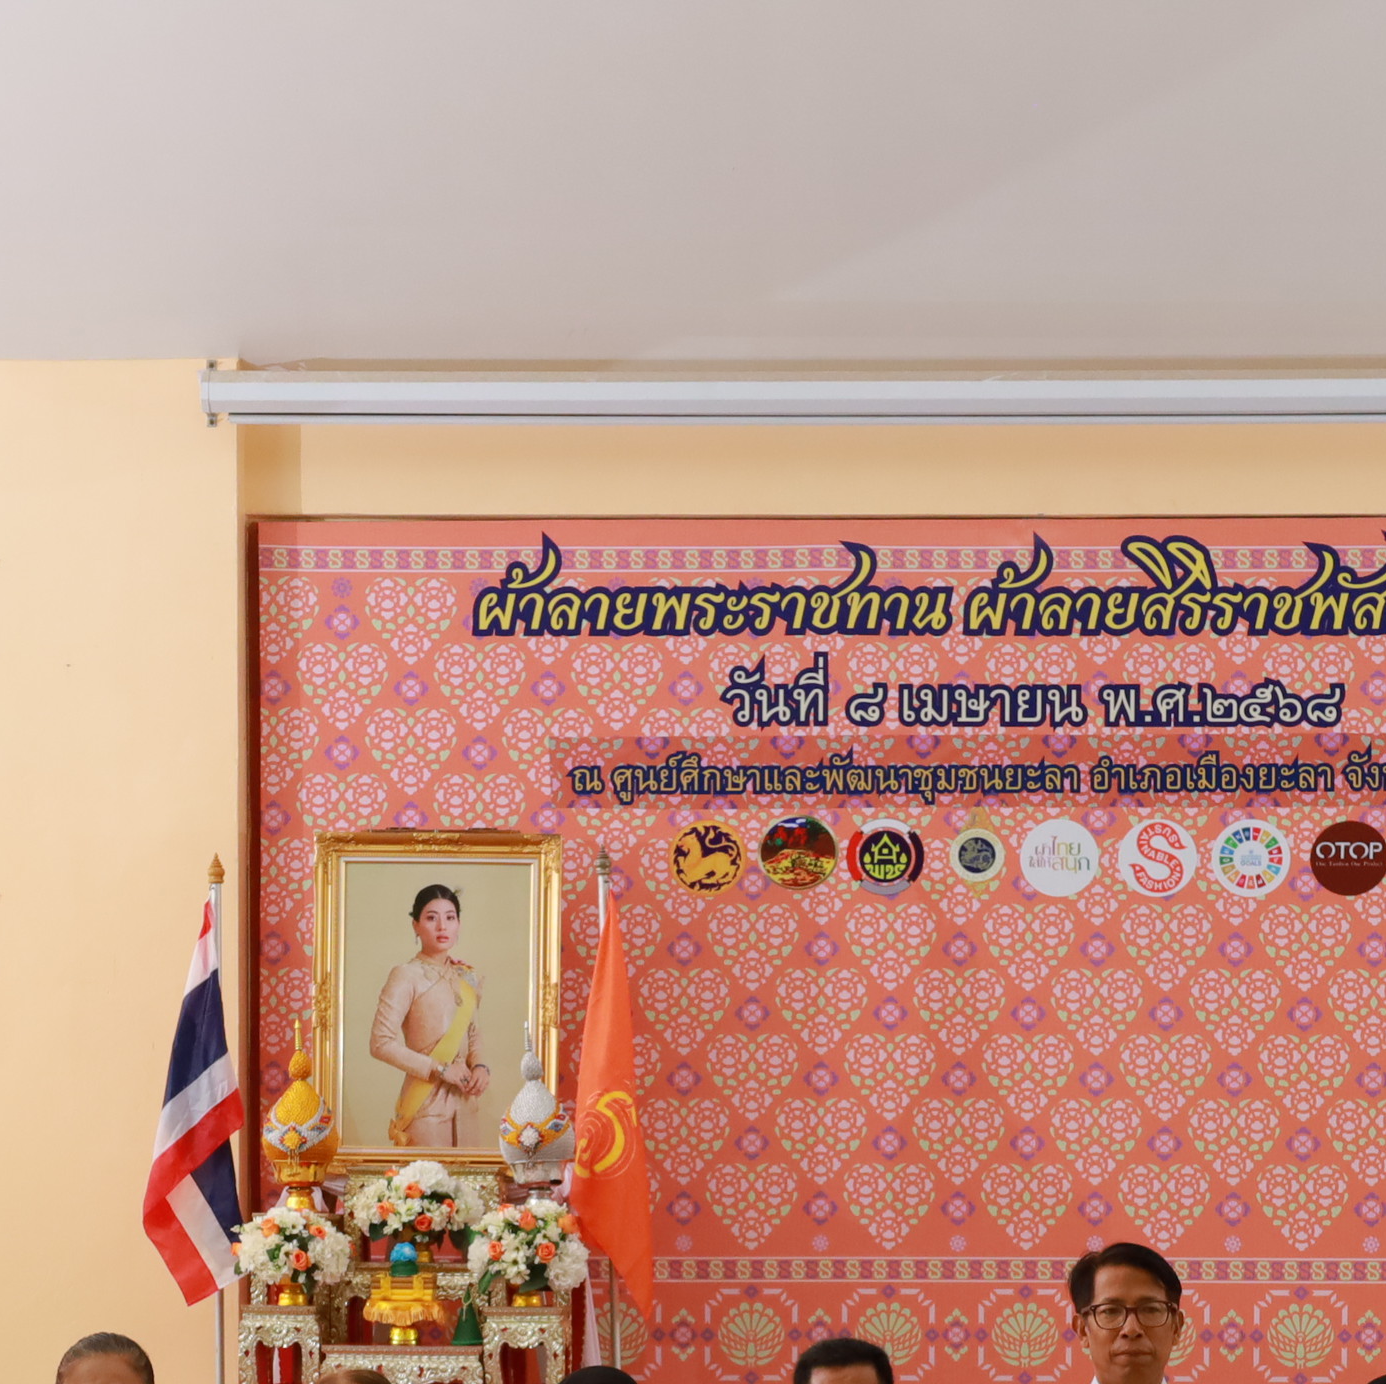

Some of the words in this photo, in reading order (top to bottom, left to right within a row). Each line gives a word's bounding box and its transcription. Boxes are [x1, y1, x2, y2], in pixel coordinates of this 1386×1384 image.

[476, 538, 950, 634] ผ้าลายพระราชทาน
[725, 655, 829, 724] วันที่
[848, 685, 885, 725] ๘
[901, 685, 1083, 725] เมษายน
[1105, 681, 1344, 725] พ.ศ.๒๕๖๘
[570, 765, 604, 793] ณ
[612, 754, 1080, 803] ศูนย์ศึกษาและพัฒนาชุมชนยะลา
[1090, 752, 1333, 793] อำเภอเมืองยะลา
[1316, 841, 1383, 859] OTOP
[1136, 870, 1181, 890] FASHION
